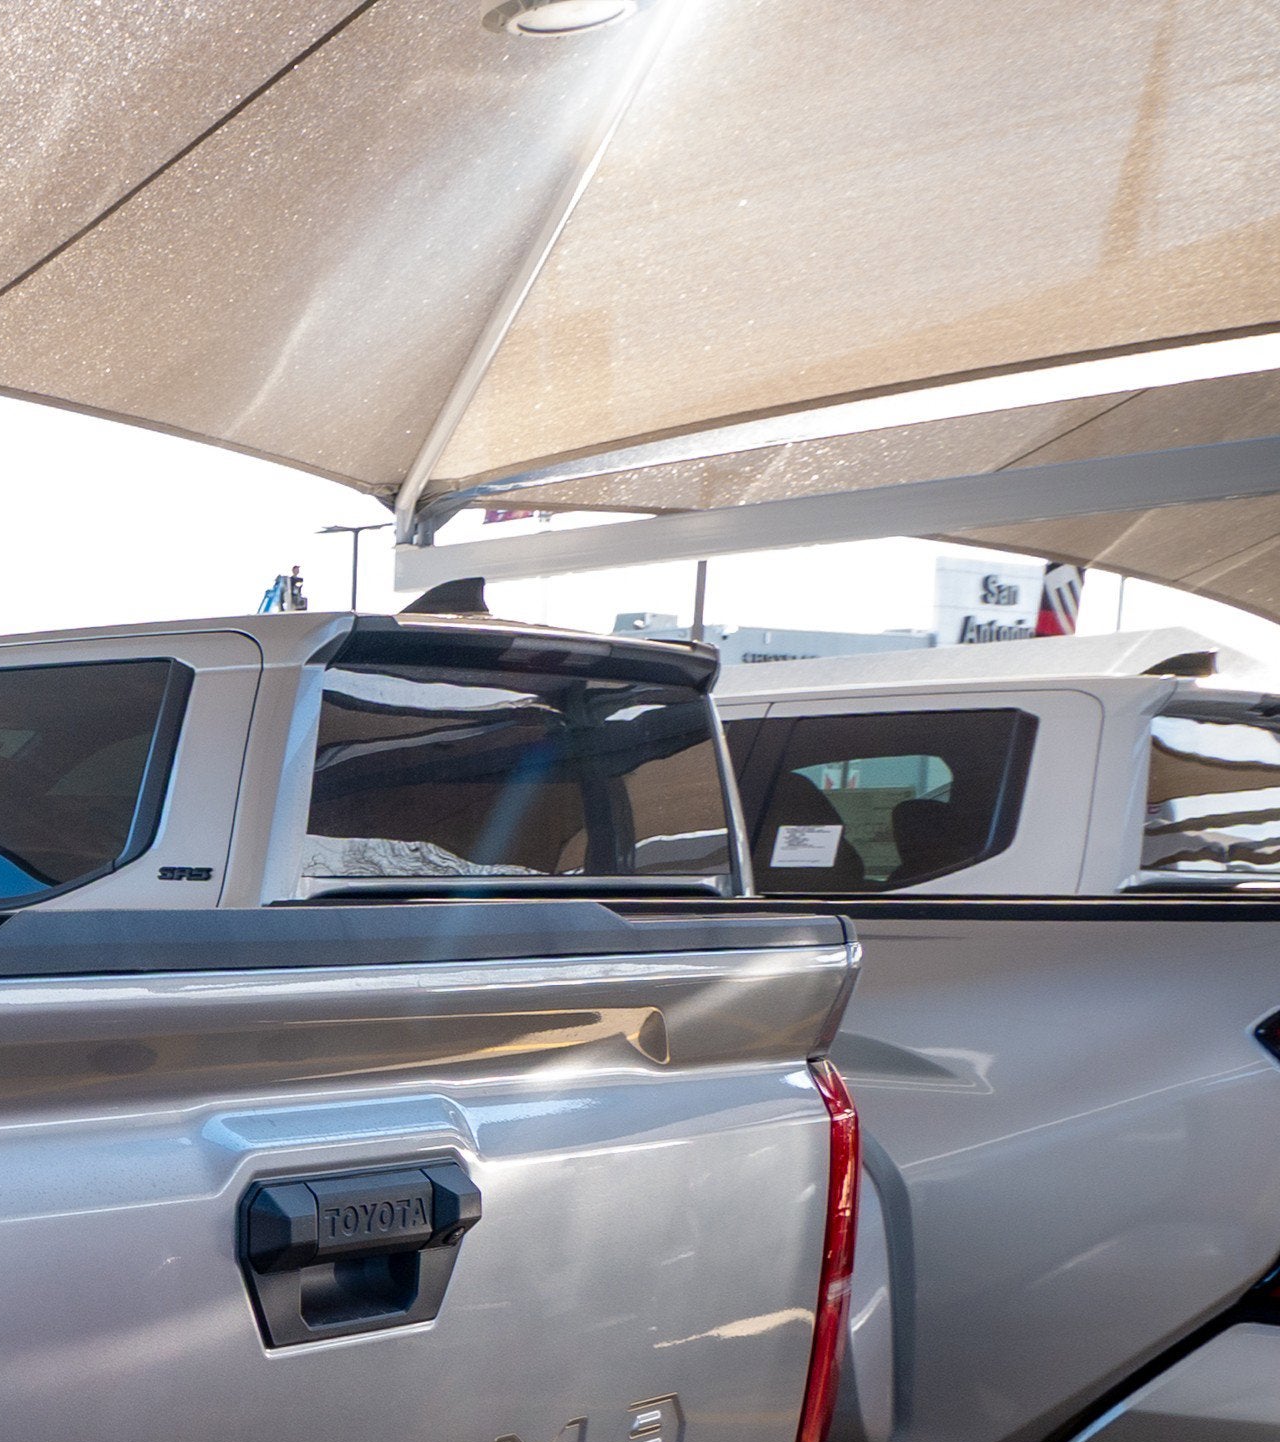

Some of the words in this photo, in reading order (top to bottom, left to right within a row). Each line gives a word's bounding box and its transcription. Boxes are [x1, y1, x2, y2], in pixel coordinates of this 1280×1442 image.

[980, 574, 1019, 605] San
[157, 866, 214, 881] SR5
[324, 1197, 428, 1239] TOYOTA
